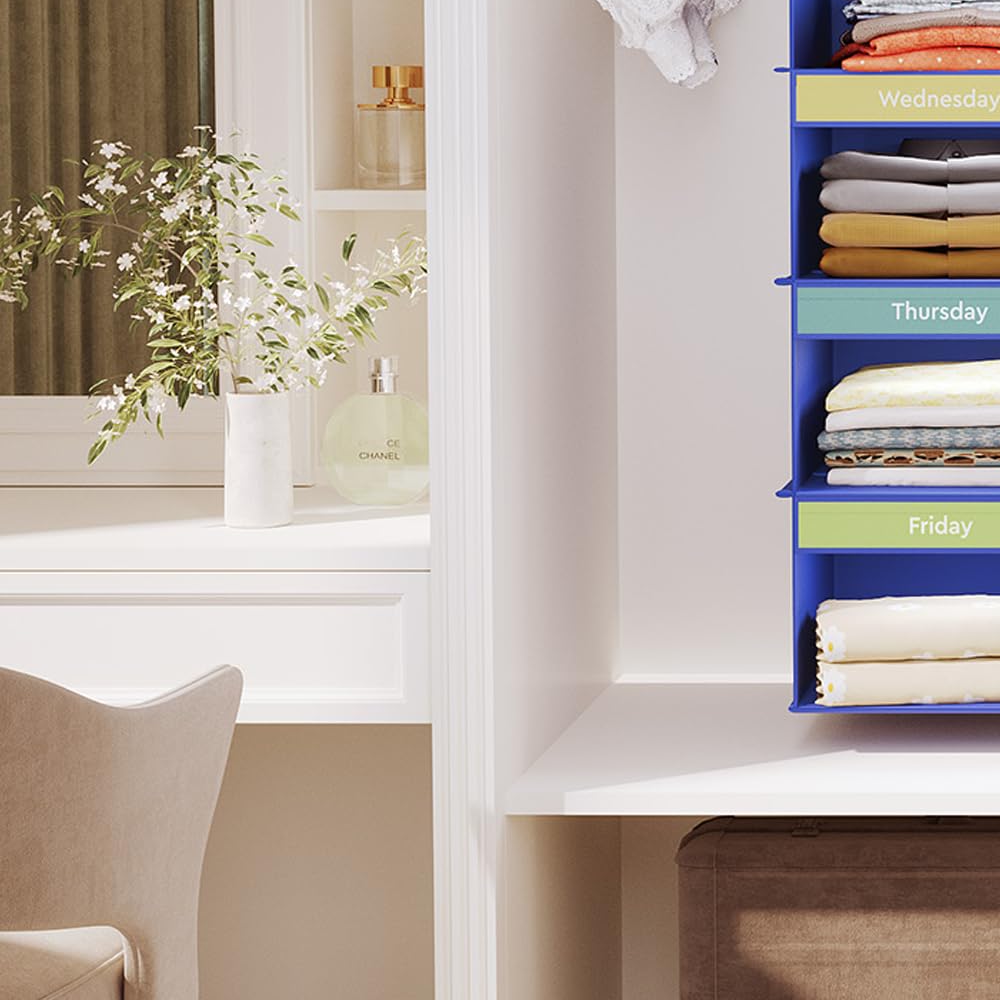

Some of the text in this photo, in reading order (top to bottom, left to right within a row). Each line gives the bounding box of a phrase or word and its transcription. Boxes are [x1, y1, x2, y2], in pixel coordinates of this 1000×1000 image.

[878, 88, 1000, 113] Wednesday
[891, 300, 989, 325] Thursday
[909, 514, 974, 539] Friday
